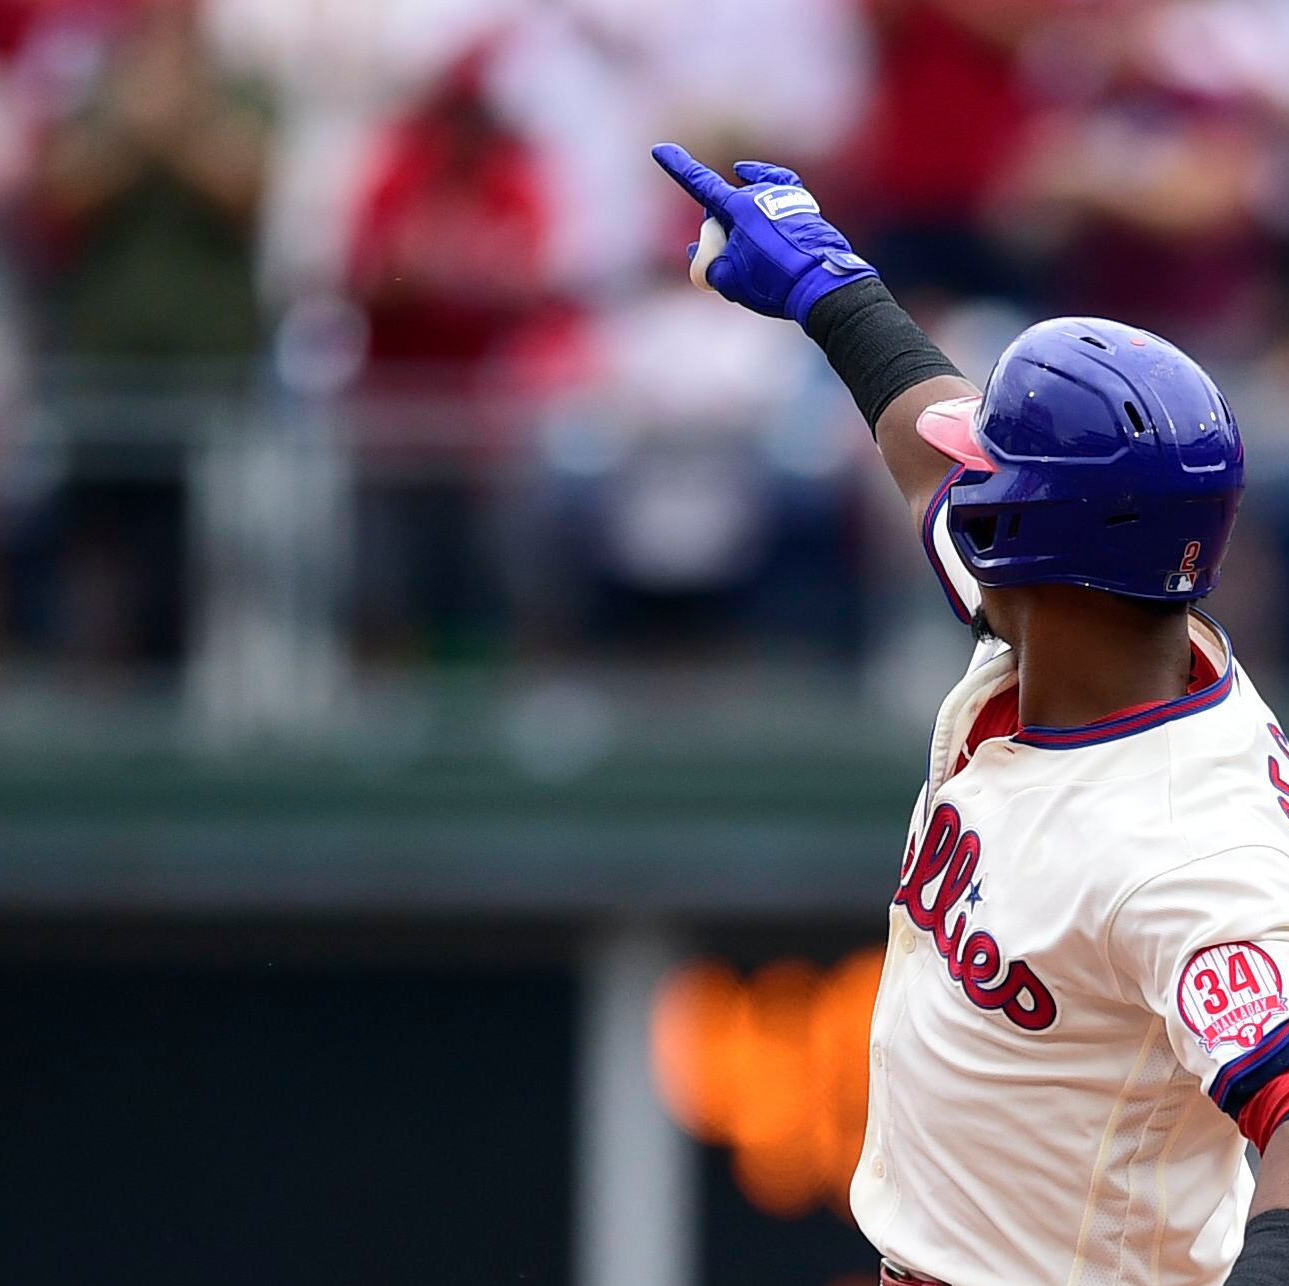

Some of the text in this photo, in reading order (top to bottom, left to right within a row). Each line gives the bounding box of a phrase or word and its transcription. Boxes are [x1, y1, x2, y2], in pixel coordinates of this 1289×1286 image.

[1180, 541, 1201, 572] 2
[894, 803, 1057, 1031] llies
[1193, 951, 1261, 1014] 34
[1211, 998, 1269, 1034] HALLADAY
